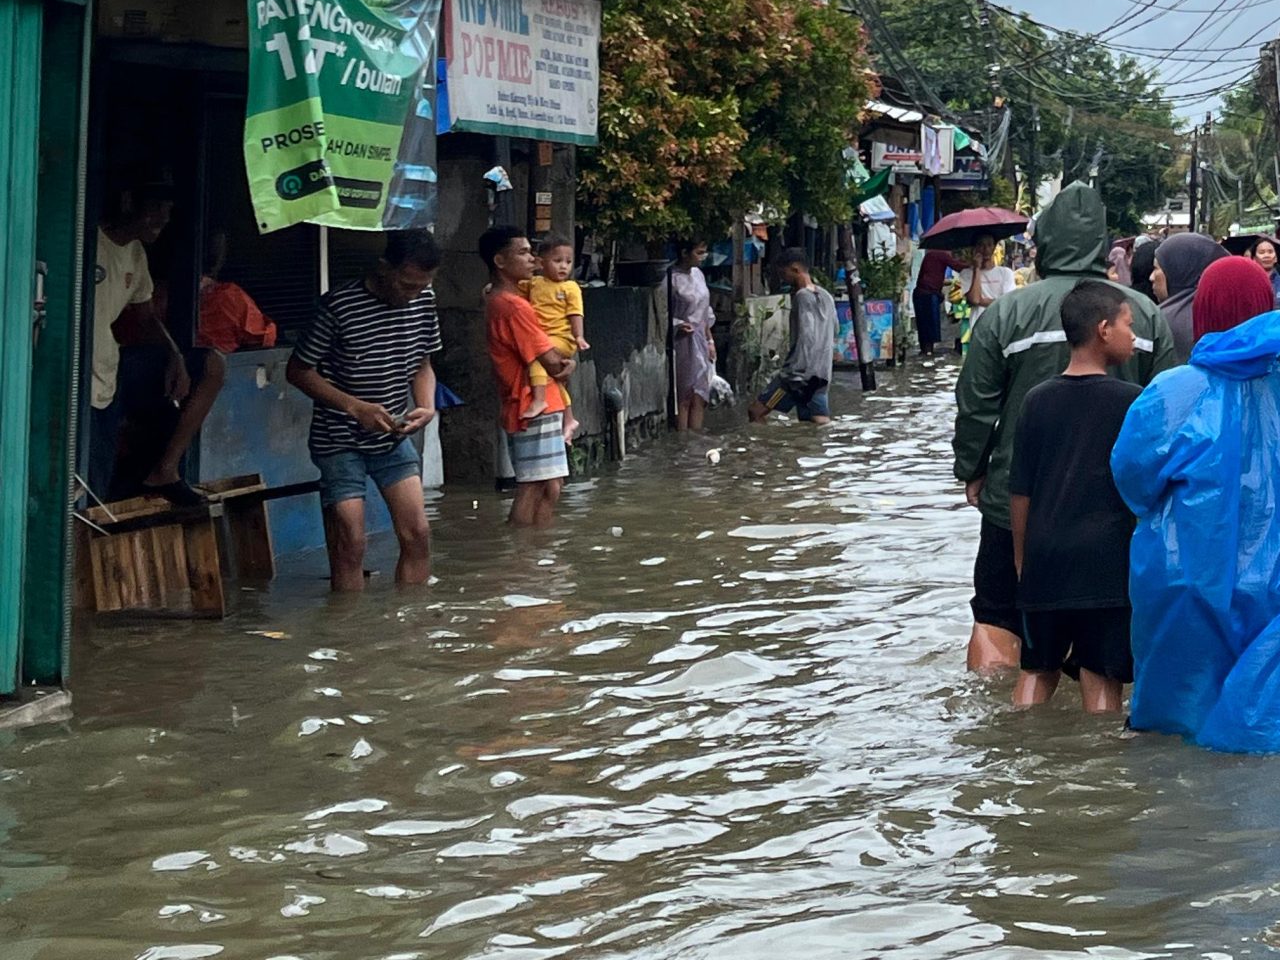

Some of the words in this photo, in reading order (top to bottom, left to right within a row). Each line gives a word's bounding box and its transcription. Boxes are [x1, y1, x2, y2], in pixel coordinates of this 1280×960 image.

[461, 31, 496, 78] POP
[496, 39, 533, 85] MIE
[260, 121, 325, 154] PROSE
[344, 143, 367, 160] DAN
